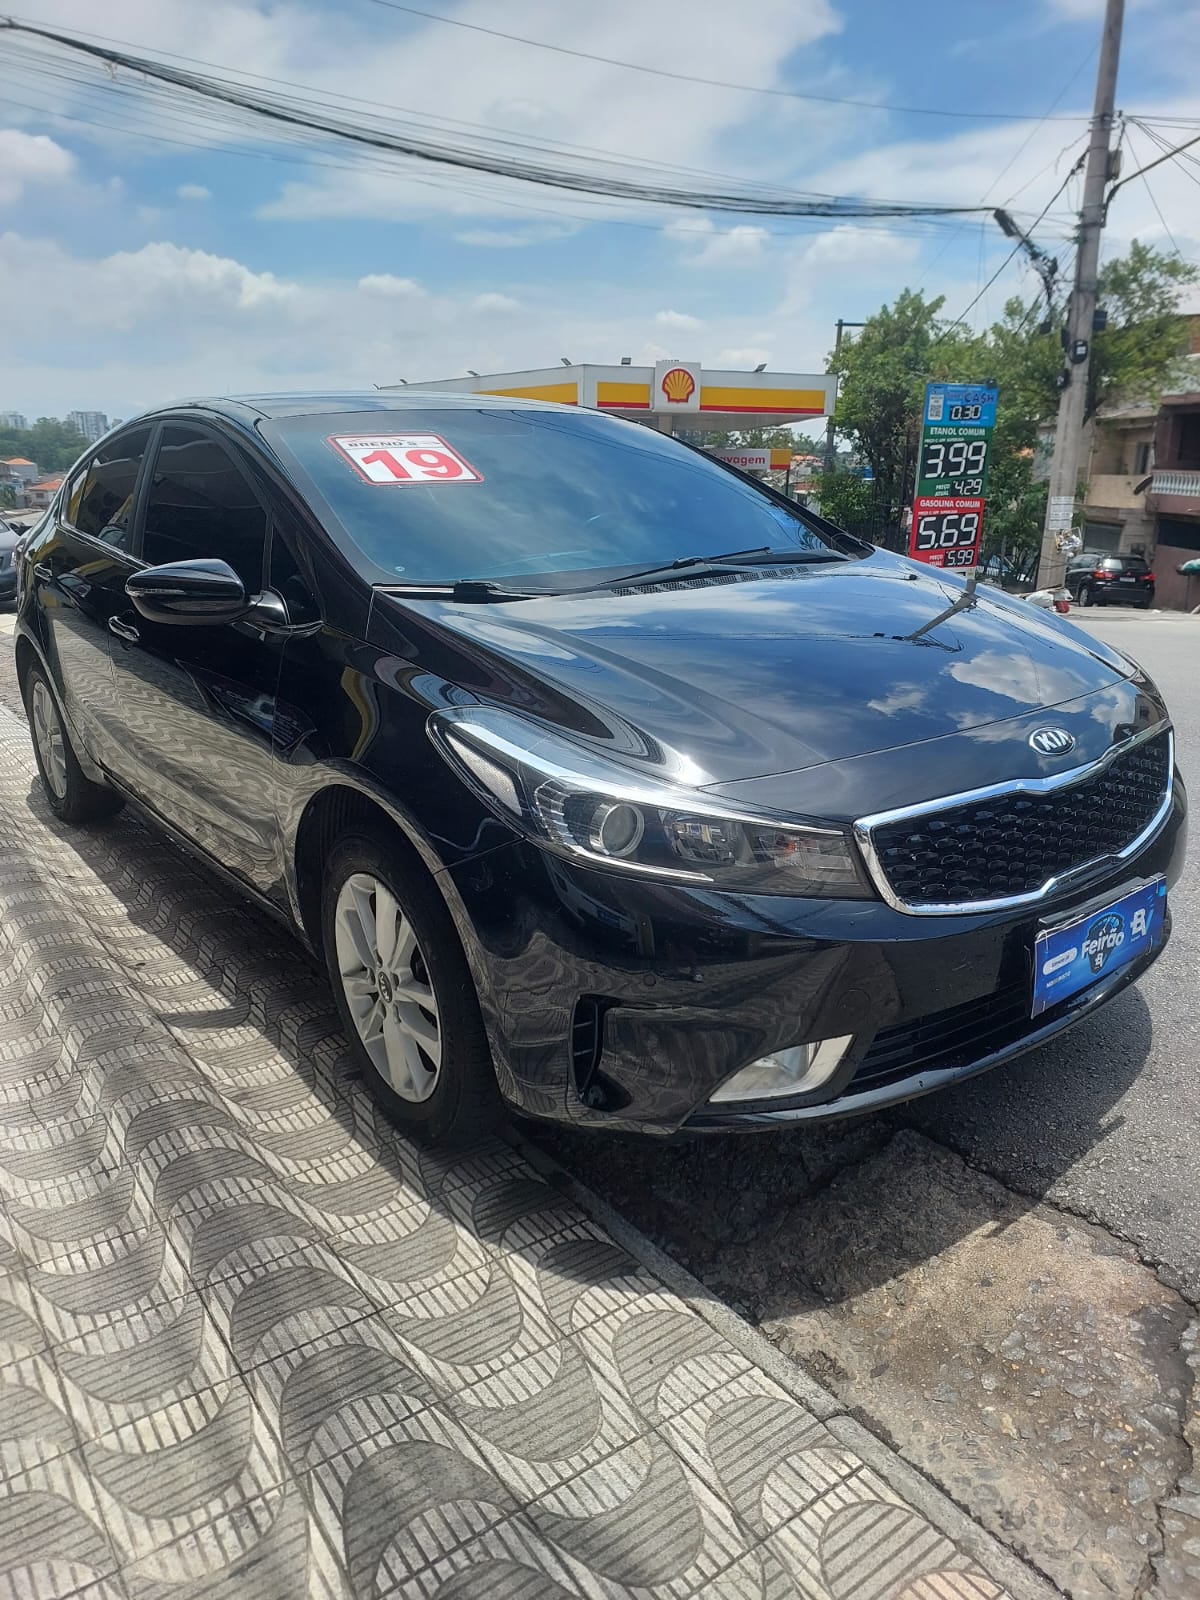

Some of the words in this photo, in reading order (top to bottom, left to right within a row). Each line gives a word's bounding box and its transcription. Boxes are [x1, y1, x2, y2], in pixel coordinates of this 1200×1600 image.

[930, 427, 957, 435] ETANOL
[959, 428, 986, 436] COMUM
[361, 449, 463, 479] 19
[925, 441, 987, 478] 3,99
[920, 500, 954, 508] GASOLINA
[918, 513, 978, 549] 5,69
[1034, 730, 1072, 751] KIA
[1081, 927, 1125, 959] Feirão
